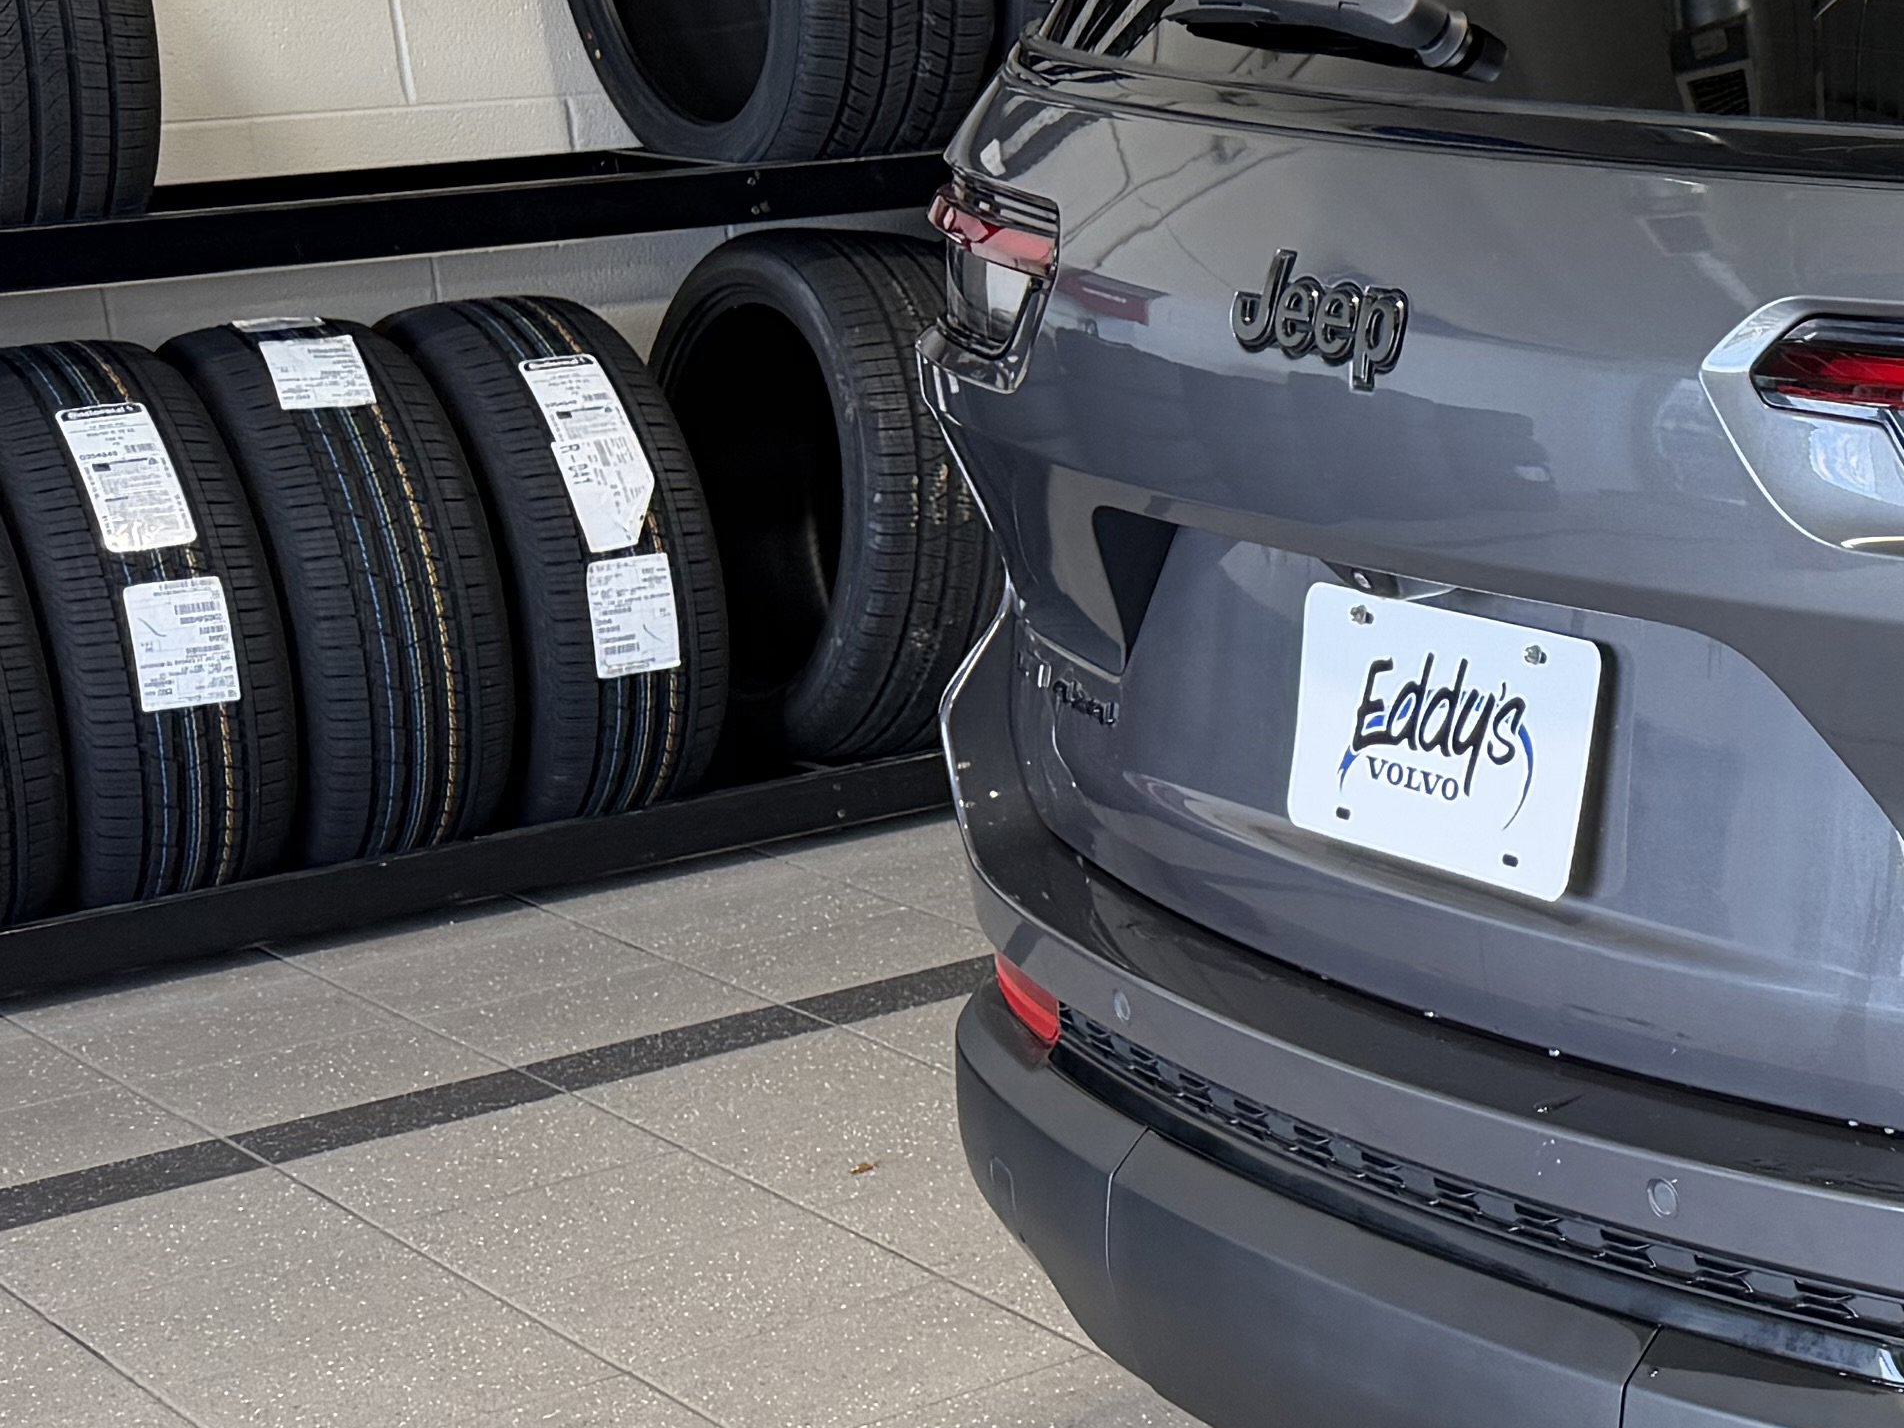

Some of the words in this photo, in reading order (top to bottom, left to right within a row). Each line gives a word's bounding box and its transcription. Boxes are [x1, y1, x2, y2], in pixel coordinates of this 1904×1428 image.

[1230, 248, 1409, 394] Jeep
[1352, 651, 1527, 798] Eddy's
[1365, 754, 1460, 802] VOLVO
